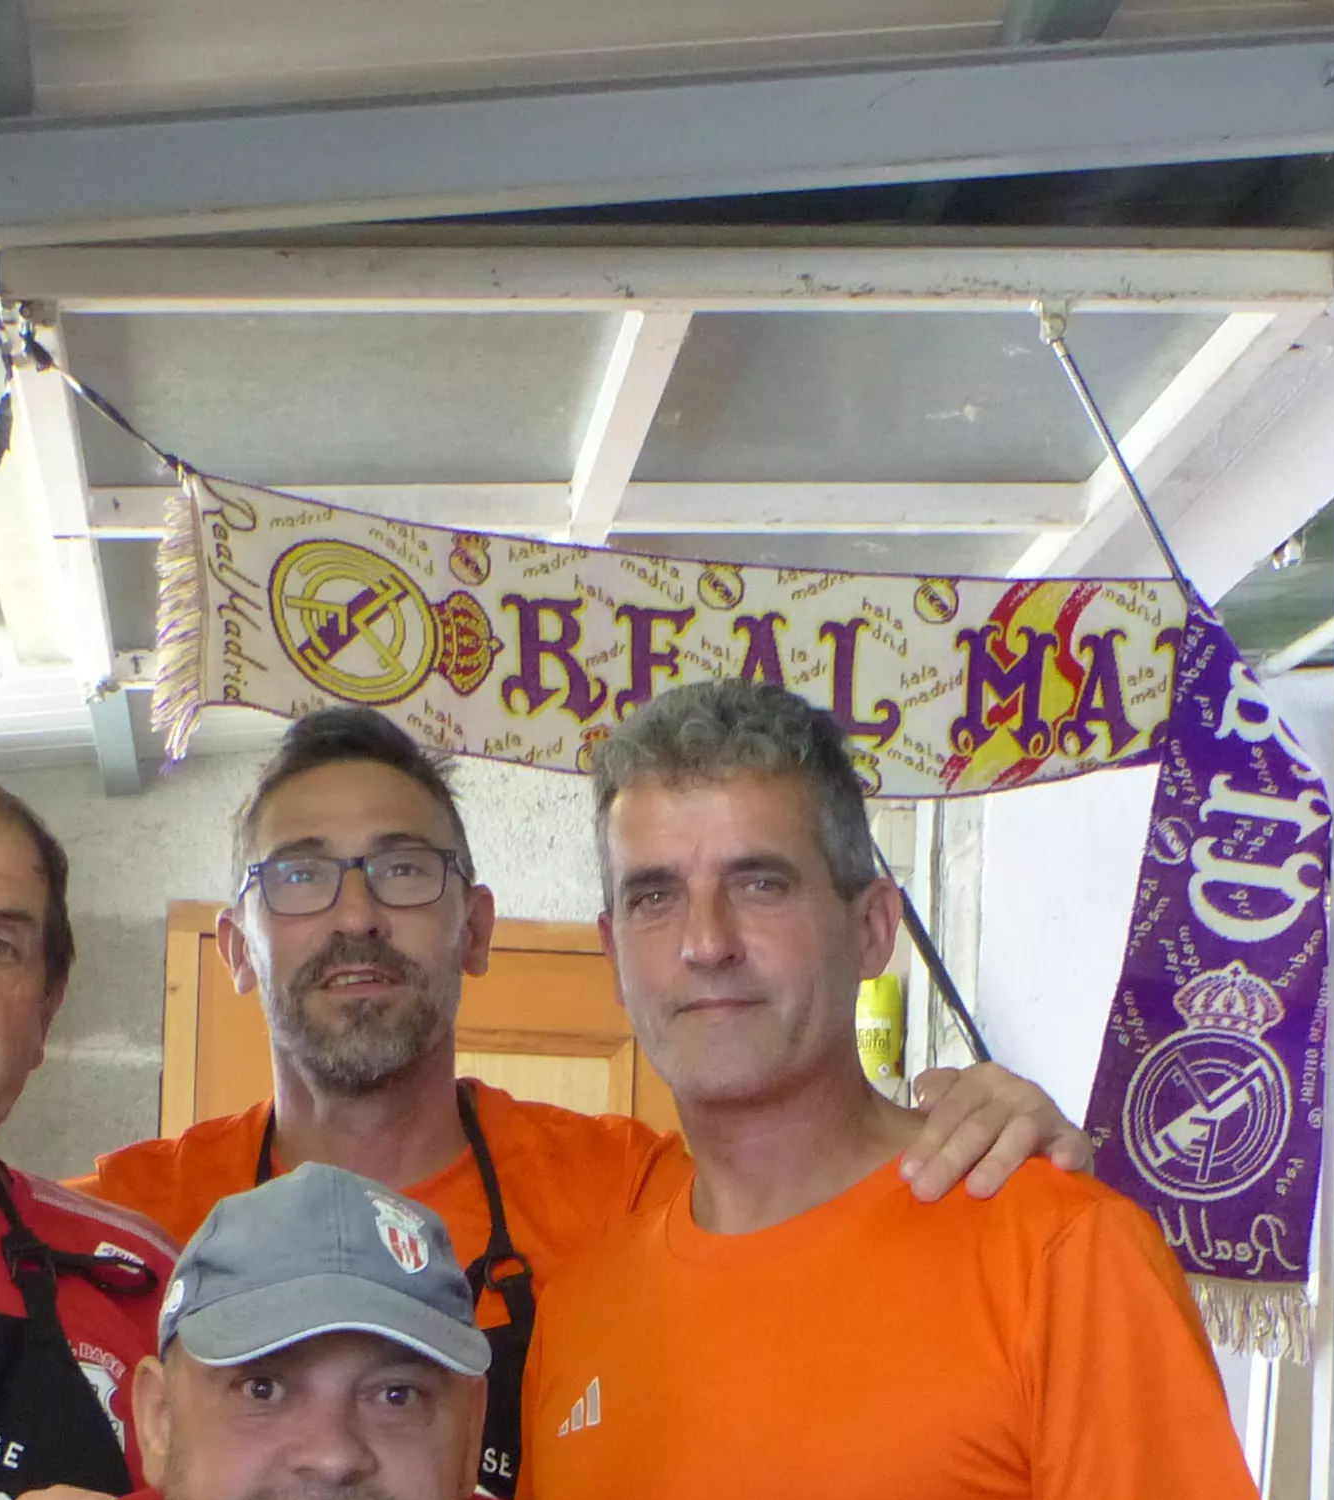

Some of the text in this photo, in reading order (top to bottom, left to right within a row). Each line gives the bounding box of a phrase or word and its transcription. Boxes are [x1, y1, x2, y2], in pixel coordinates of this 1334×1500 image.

[369, 527, 434, 576] madrid
[620, 556, 684, 604] madrid
[1127, 580, 1159, 602] ala
[585, 643, 626, 666] madr
[871, 626, 908, 657] drid
[900, 663, 939, 690] hala
[1126, 666, 1156, 686] ala
[1130, 674, 1168, 706] mad
[482, 1447, 512, 1478] SE
